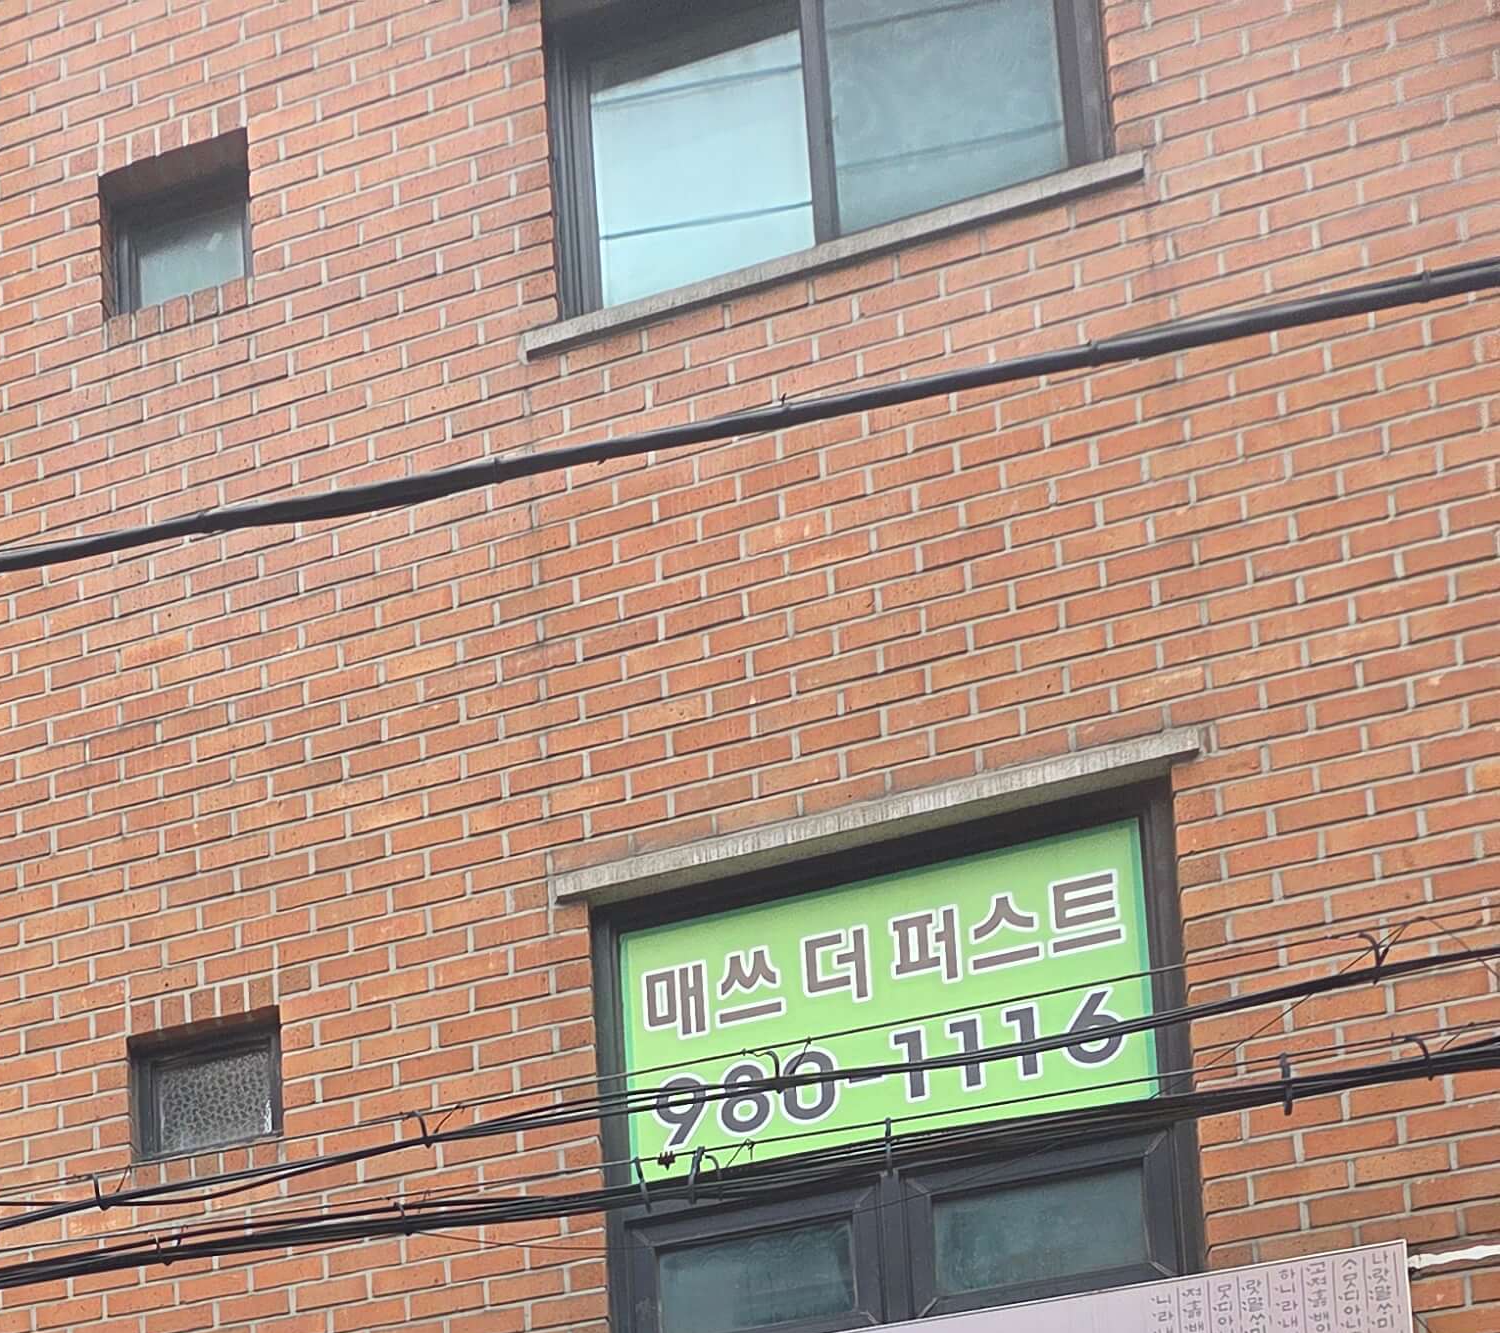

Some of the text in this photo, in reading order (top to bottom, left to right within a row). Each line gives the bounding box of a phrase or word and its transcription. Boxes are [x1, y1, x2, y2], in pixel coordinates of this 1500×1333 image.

[645, 873, 1122, 1035] 매쓰 더 퍼스트
[654, 990, 1125, 1148] 980-1116
